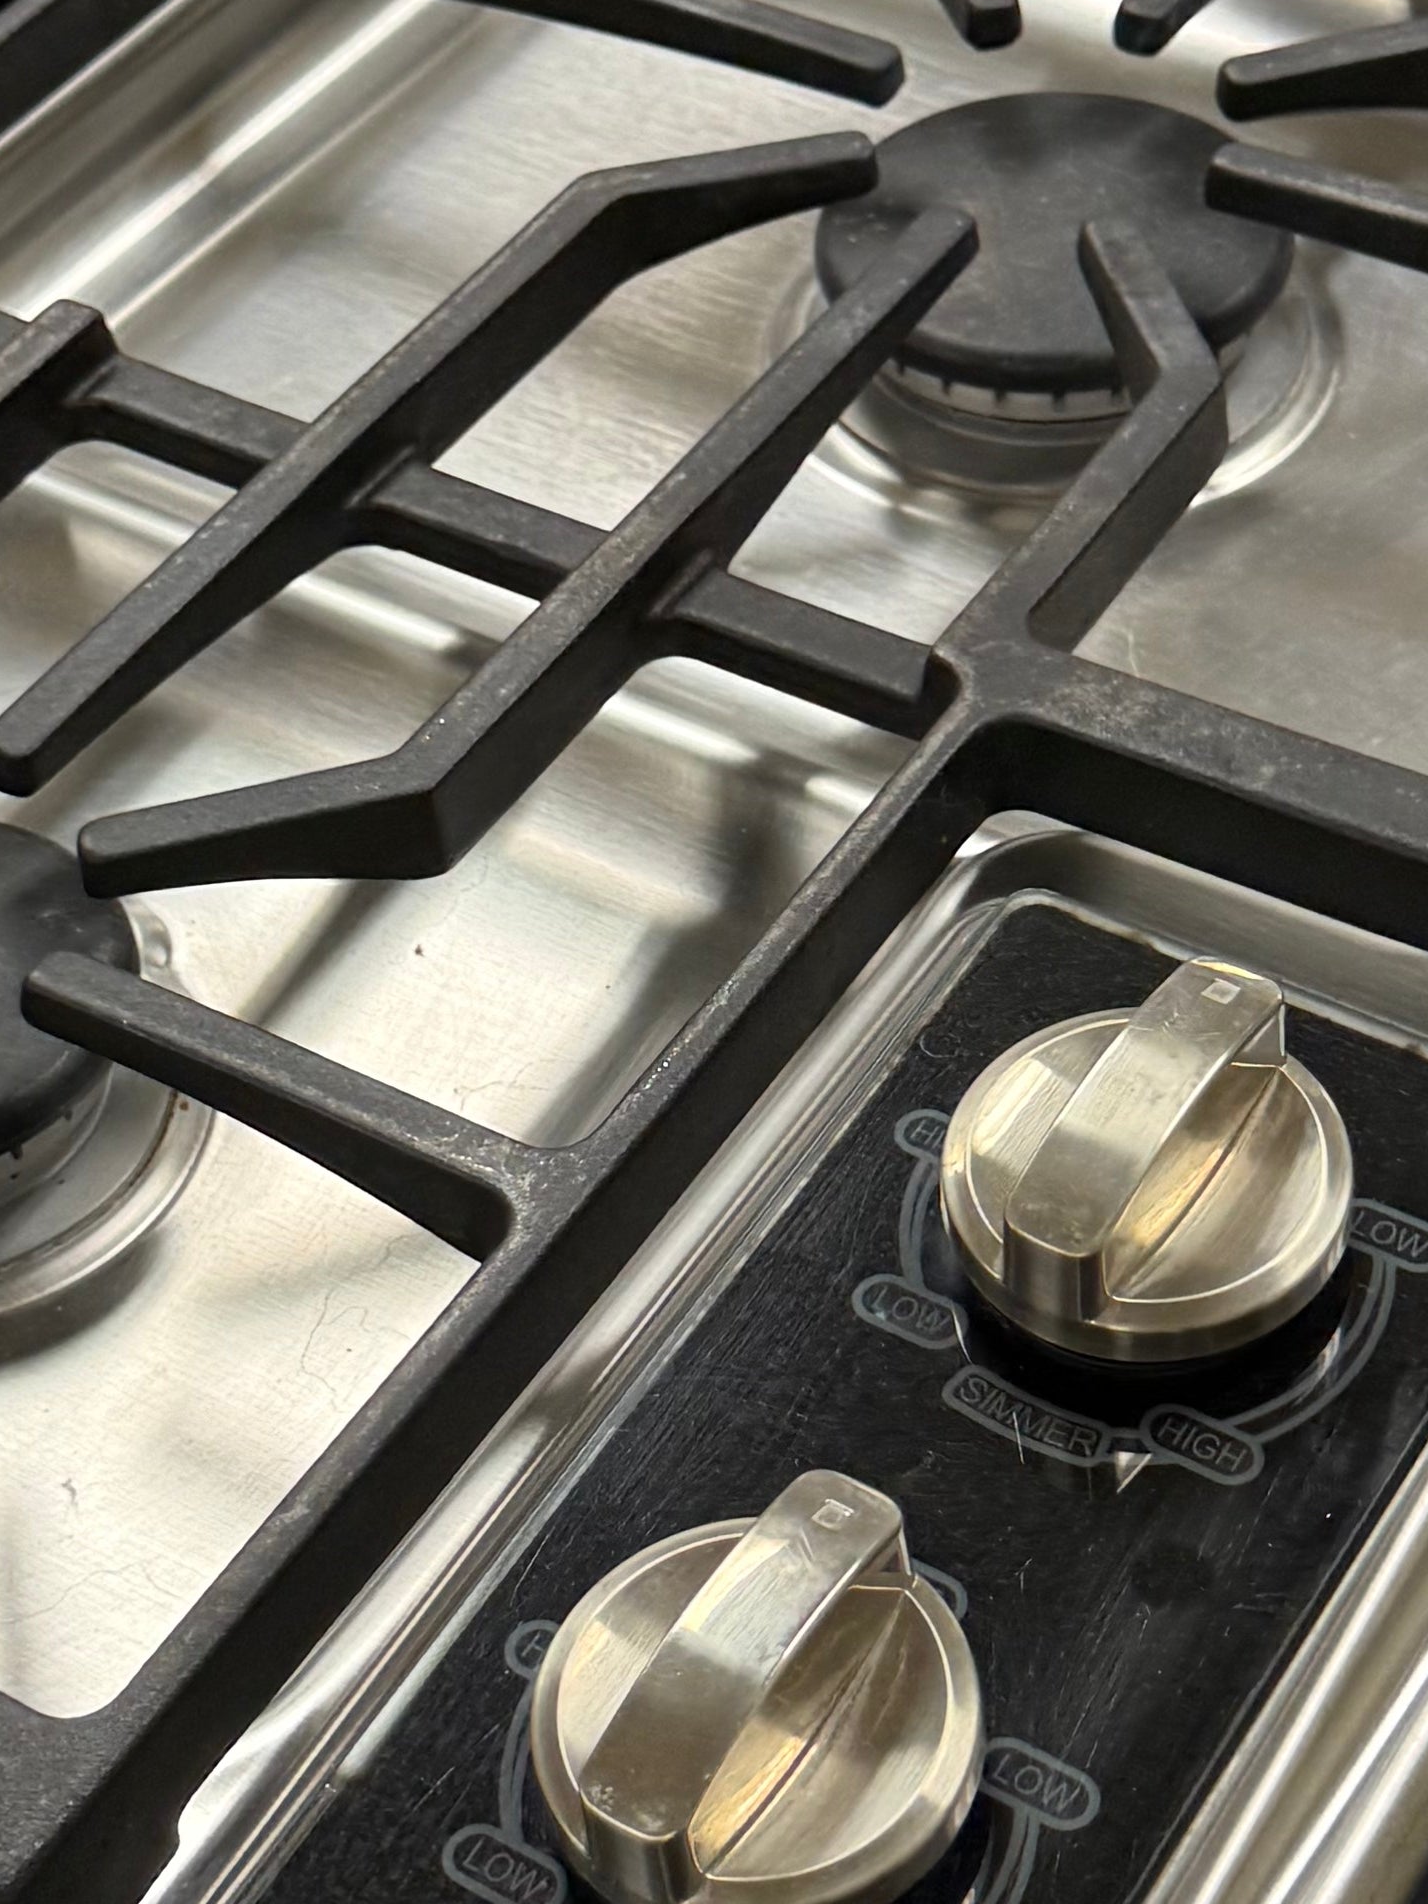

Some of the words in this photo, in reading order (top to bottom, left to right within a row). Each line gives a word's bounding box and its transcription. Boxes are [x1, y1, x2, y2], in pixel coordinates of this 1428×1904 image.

[874, 1284, 949, 1334] LOW
[959, 1374, 1098, 1457] SIMMER
[1155, 1414, 1252, 1473] HIGH
[988, 1750, 1084, 1812] LOW
[462, 1837, 548, 1899] LOW
